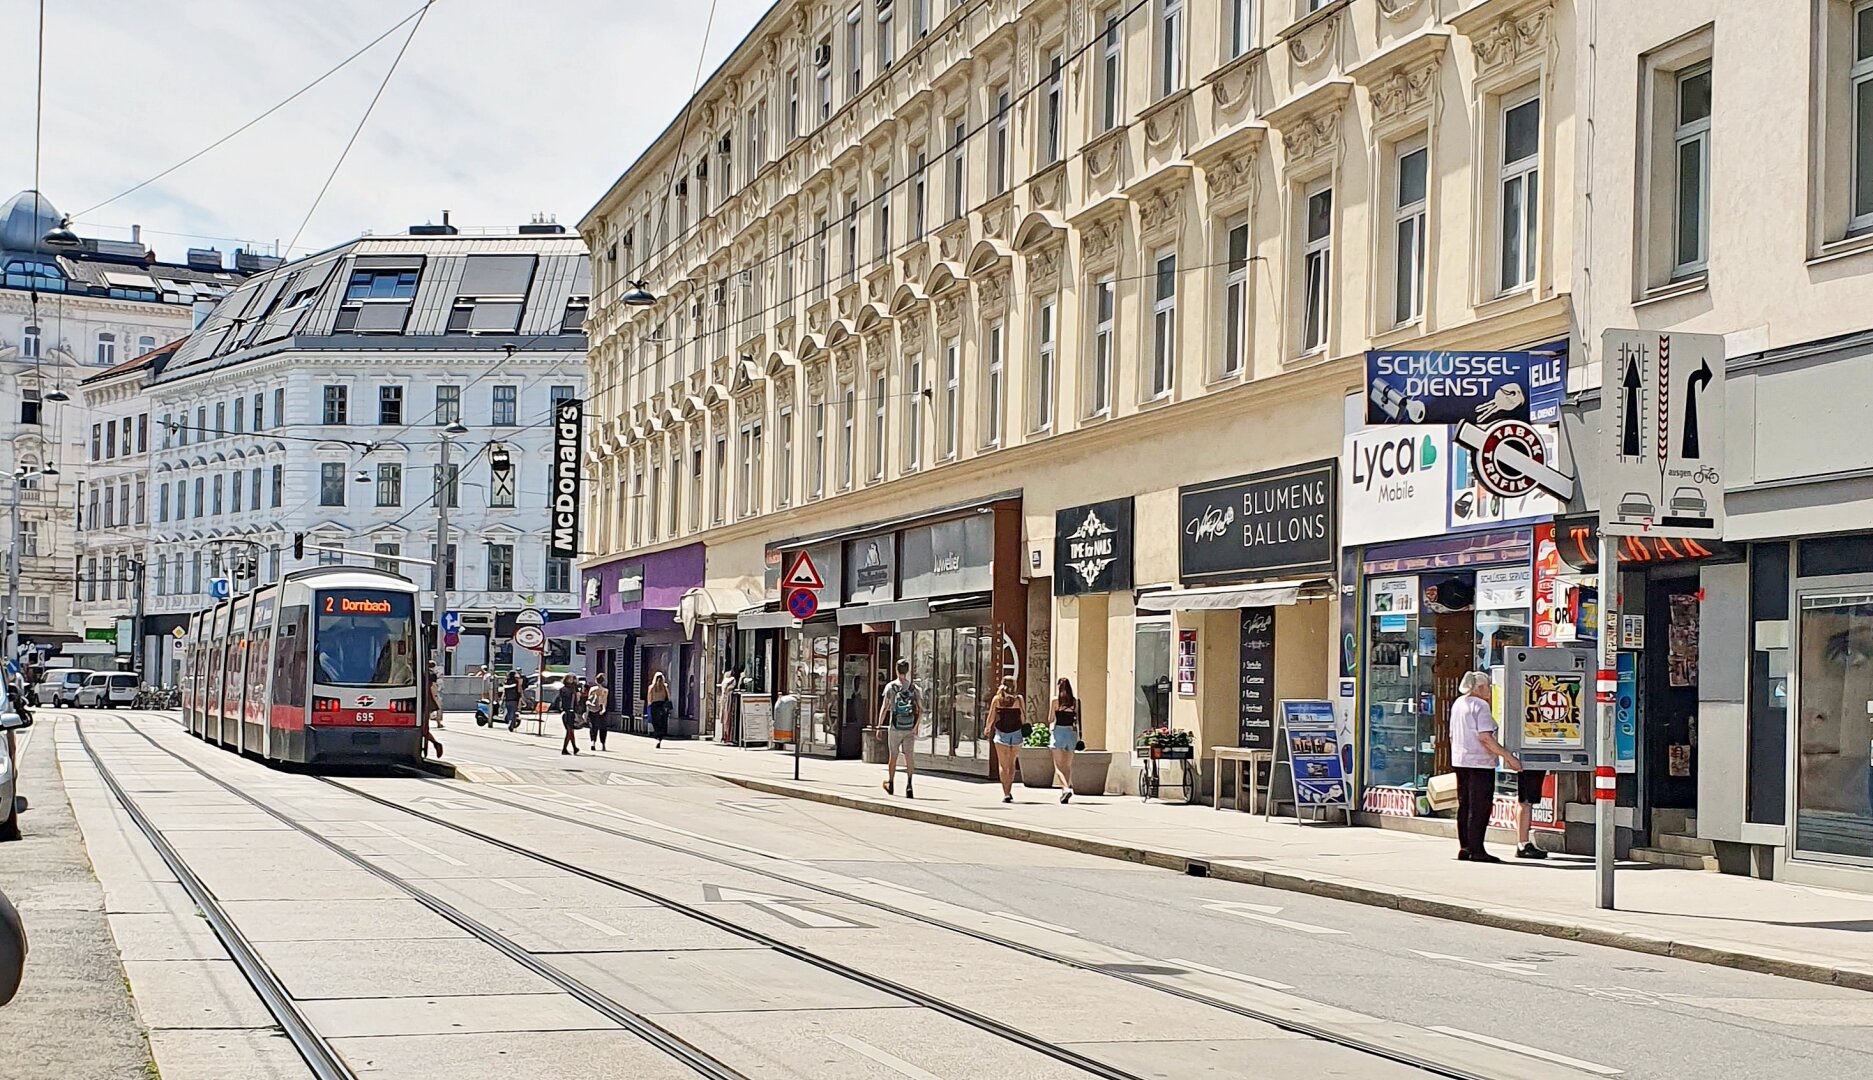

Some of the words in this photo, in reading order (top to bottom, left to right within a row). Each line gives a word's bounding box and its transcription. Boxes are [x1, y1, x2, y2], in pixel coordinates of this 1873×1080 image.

[1376, 353, 1520, 376] SCHLÜSSEL-
[1530, 359, 1561, 388] ELLE
[1406, 377, 1493, 397] DIENST
[1537, 406, 1557, 421] DIENST
[1493, 425, 1544, 456] TABAK
[1352, 436, 1415, 492] Lyca
[1483, 450, 1529, 491] TRAFIK
[554, 405, 578, 551] McDonald's
[1243, 480, 1325, 516] BLUMEN&
[1378, 482, 1414, 504] Mobile
[1243, 514, 1325, 547] BALLONS
[1070, 542, 1085, 560] TIME
[1094, 538, 1112, 556] NAILS
[1570, 528, 1713, 563] TBAK
[217, 579, 229, 595] U
[326, 596, 334, 612] 2
[342, 598, 391, 612] Dornbach
[1528, 682, 1581, 707] LUCKY
[355, 712, 375, 722] 695
[1525, 707, 1581, 724] STRIKE
[1366, 791, 1411, 810] NOTDIENST
[1531, 808, 1553, 823] HAUS
